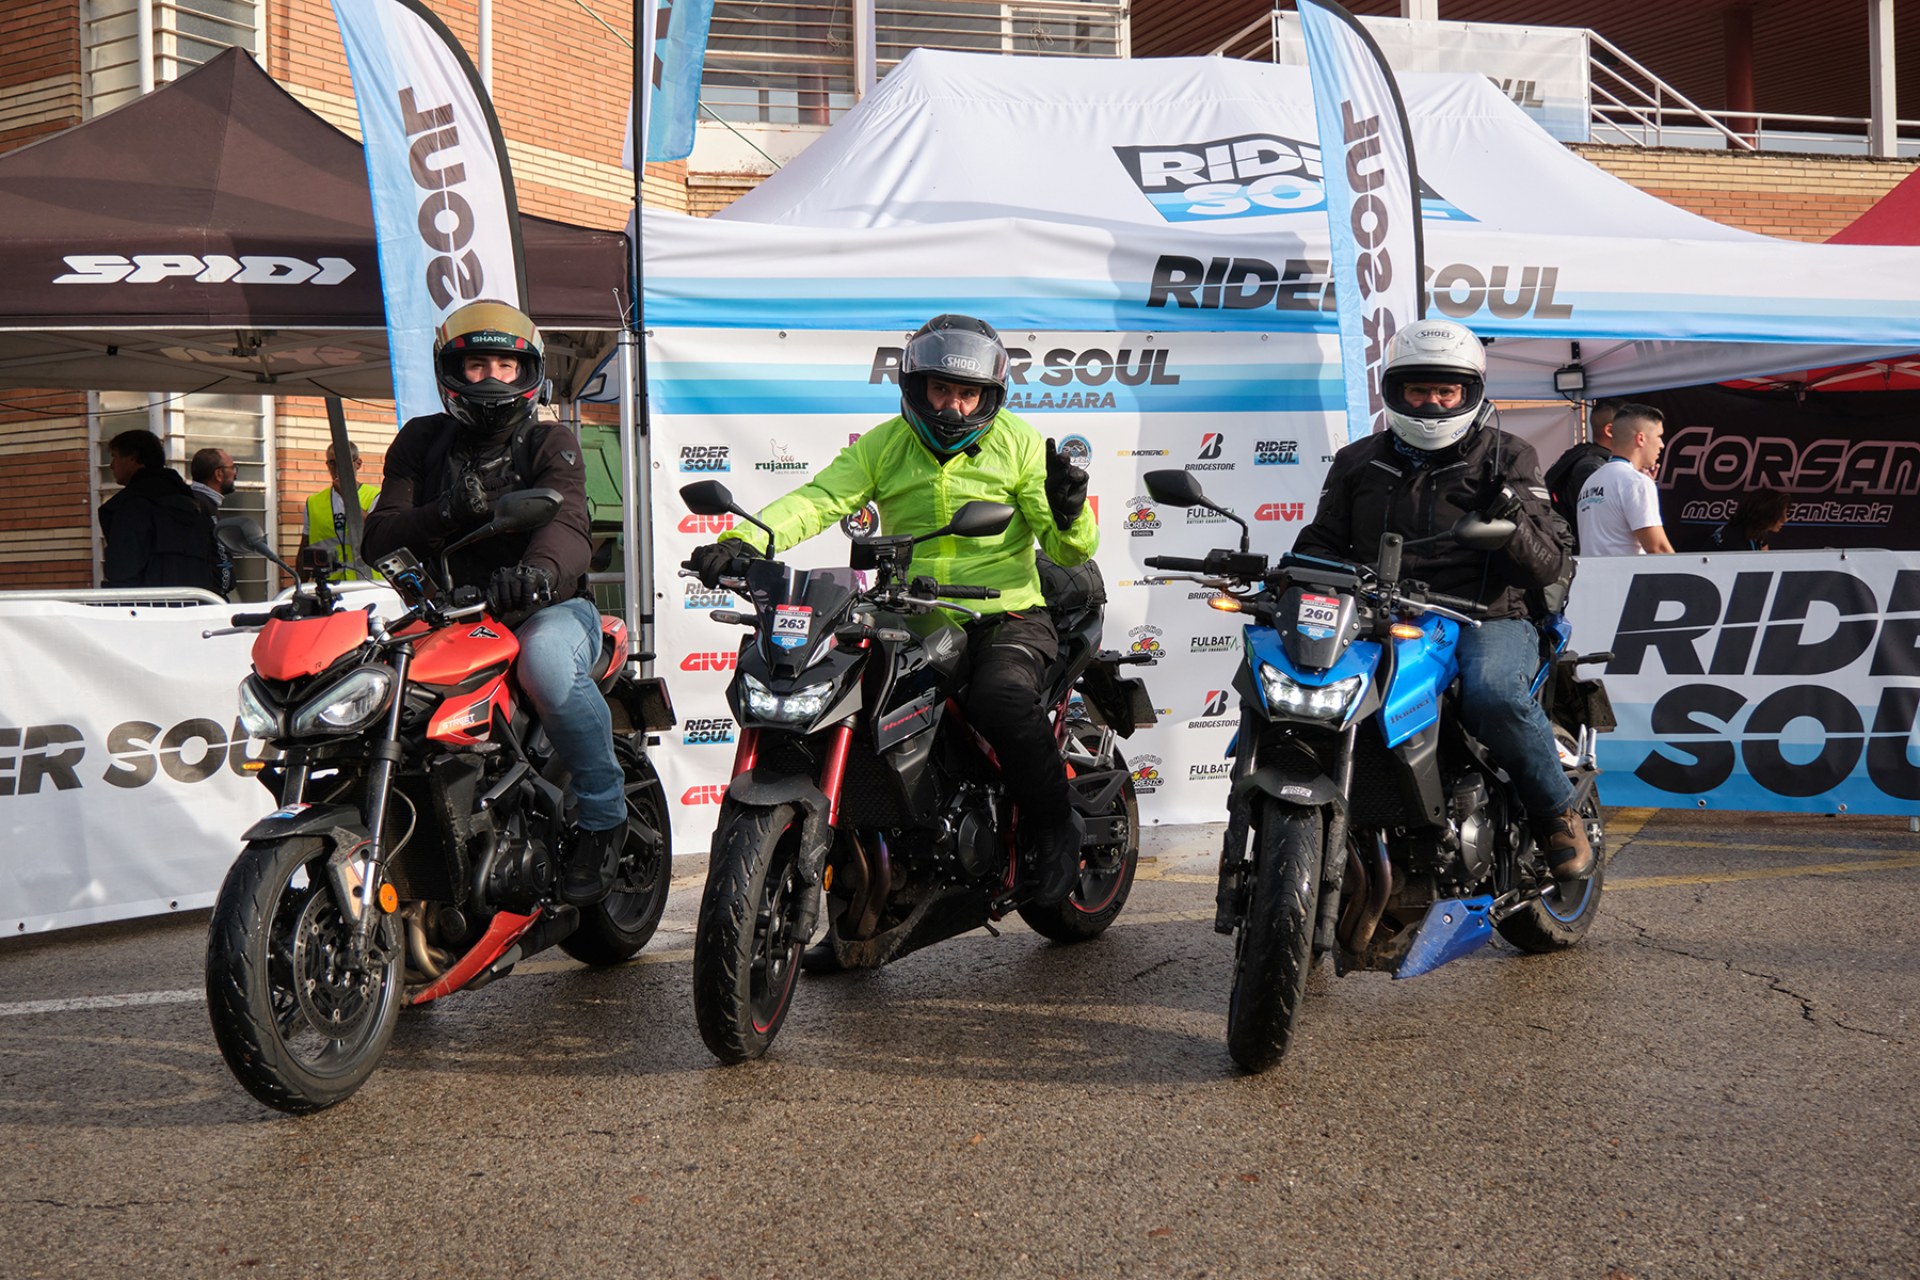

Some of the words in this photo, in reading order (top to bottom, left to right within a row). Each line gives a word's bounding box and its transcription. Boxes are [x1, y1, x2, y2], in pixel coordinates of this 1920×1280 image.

[1183, 174, 1326, 216] SO
[52, 255, 357, 285] SPIDI
[1146, 254, 1337, 312] RIDE
[472, 336, 508, 344] SHARK
[946, 357, 977, 370] SHOEI
[1039, 347, 1180, 386] SOUL
[1006, 391, 1117, 409] ALAJARA
[680, 446, 730, 458] RIDER
[1255, 440, 1298, 452] RIDER
[683, 458, 727, 471] SOUL
[1259, 452, 1296, 464] SOUL
[755, 460, 808, 472] rujamar
[1185, 462, 1236, 471] BRIDGESTONE
[1187, 508, 1229, 518] FULBA
[1254, 502, 1305, 522] GIVI
[1681, 500, 1738, 520] mot
[677, 513, 734, 535] GIVI
[1123, 520, 1162, 530] LORENZO
[689, 594, 730, 608] SOUL
[1303, 608, 1334, 621] 260
[778, 618, 806, 629] 263
[1191, 636, 1231, 647] FULBAT
[680, 652, 736, 671] GIVI
[684, 718, 733, 731] RIDER
[1188, 718, 1241, 729] BRIDGESTONE
[688, 730, 731, 743] SOUL
[103, 716, 279, 789] SOU
[1190, 763, 1230, 775] FULBAT
[1133, 777, 1165, 788] ORENZO
[681, 784, 729, 805] GIV
